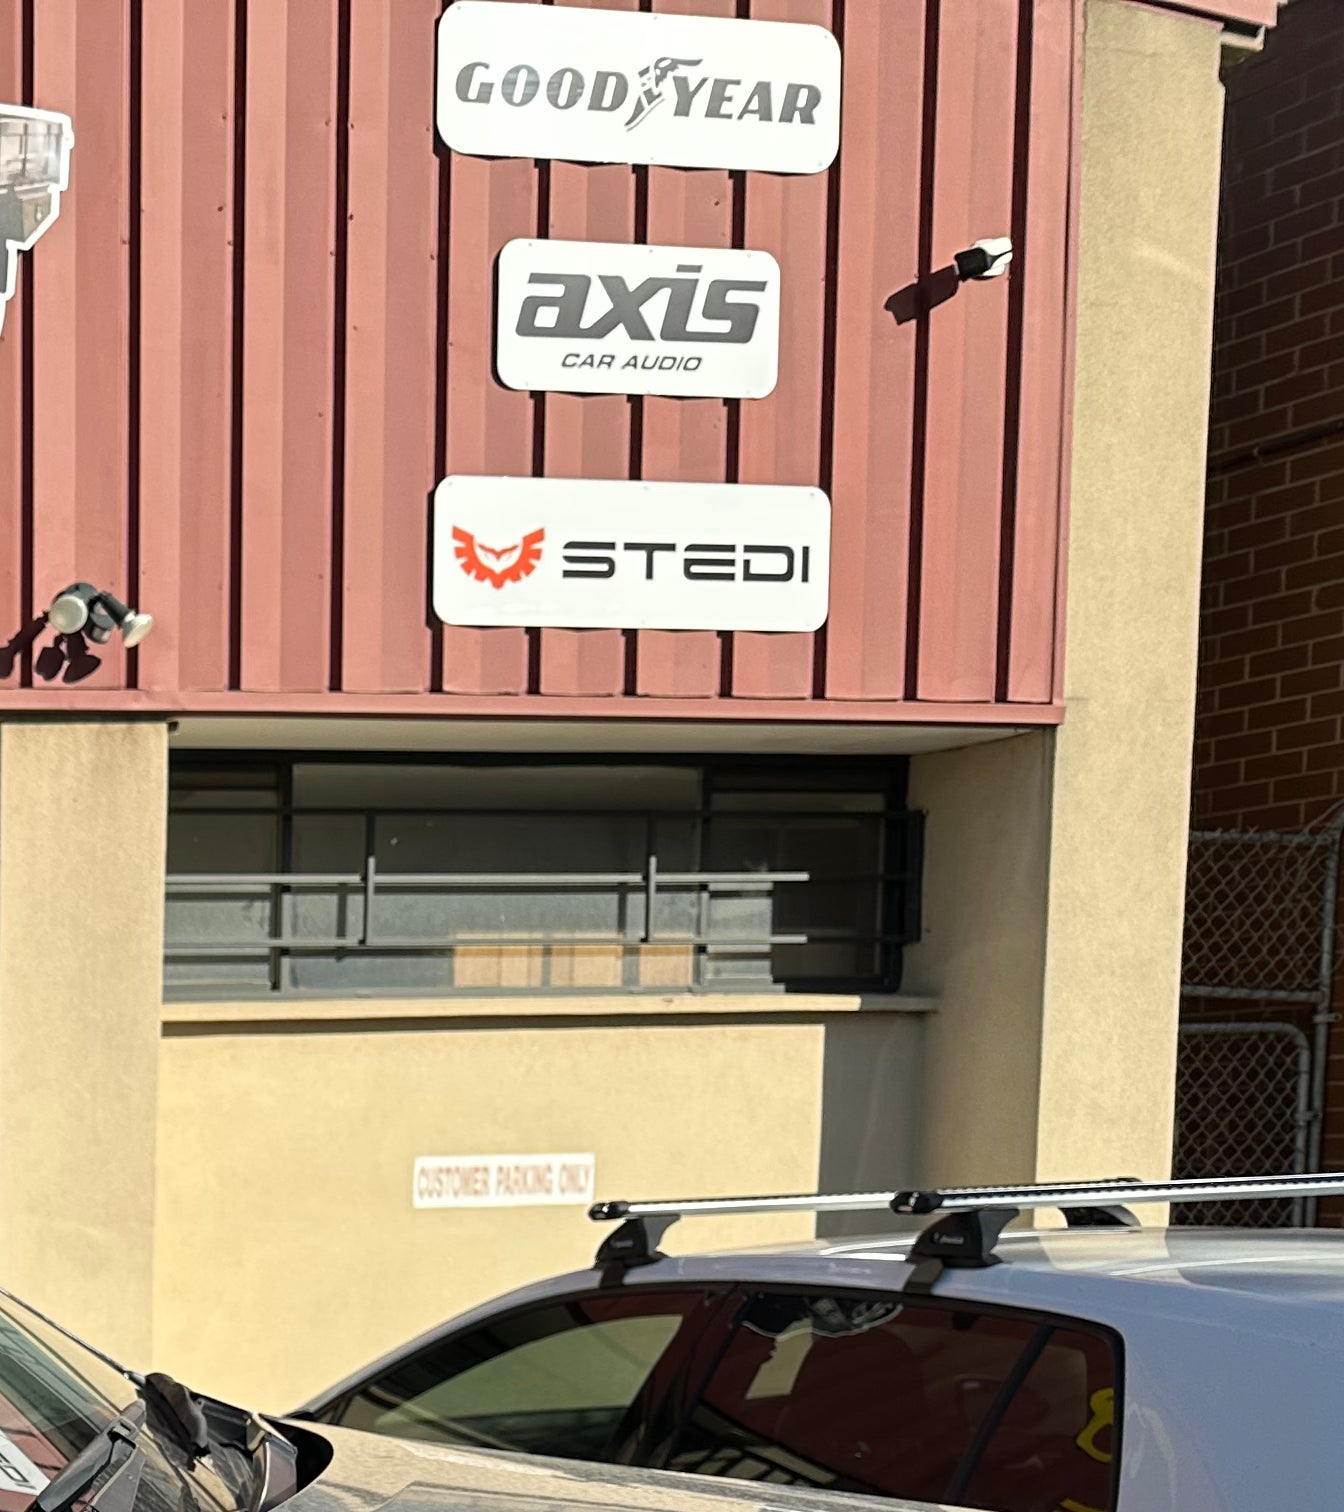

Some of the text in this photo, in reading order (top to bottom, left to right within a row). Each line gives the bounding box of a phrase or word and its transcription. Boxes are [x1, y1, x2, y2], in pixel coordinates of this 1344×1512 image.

[515, 264, 768, 344] axis
[561, 352, 702, 372] CAR AUDIO
[562, 541, 810, 583] STEDI
[419, 1163, 591, 1198] CUSTOMER PARKING ONLY
